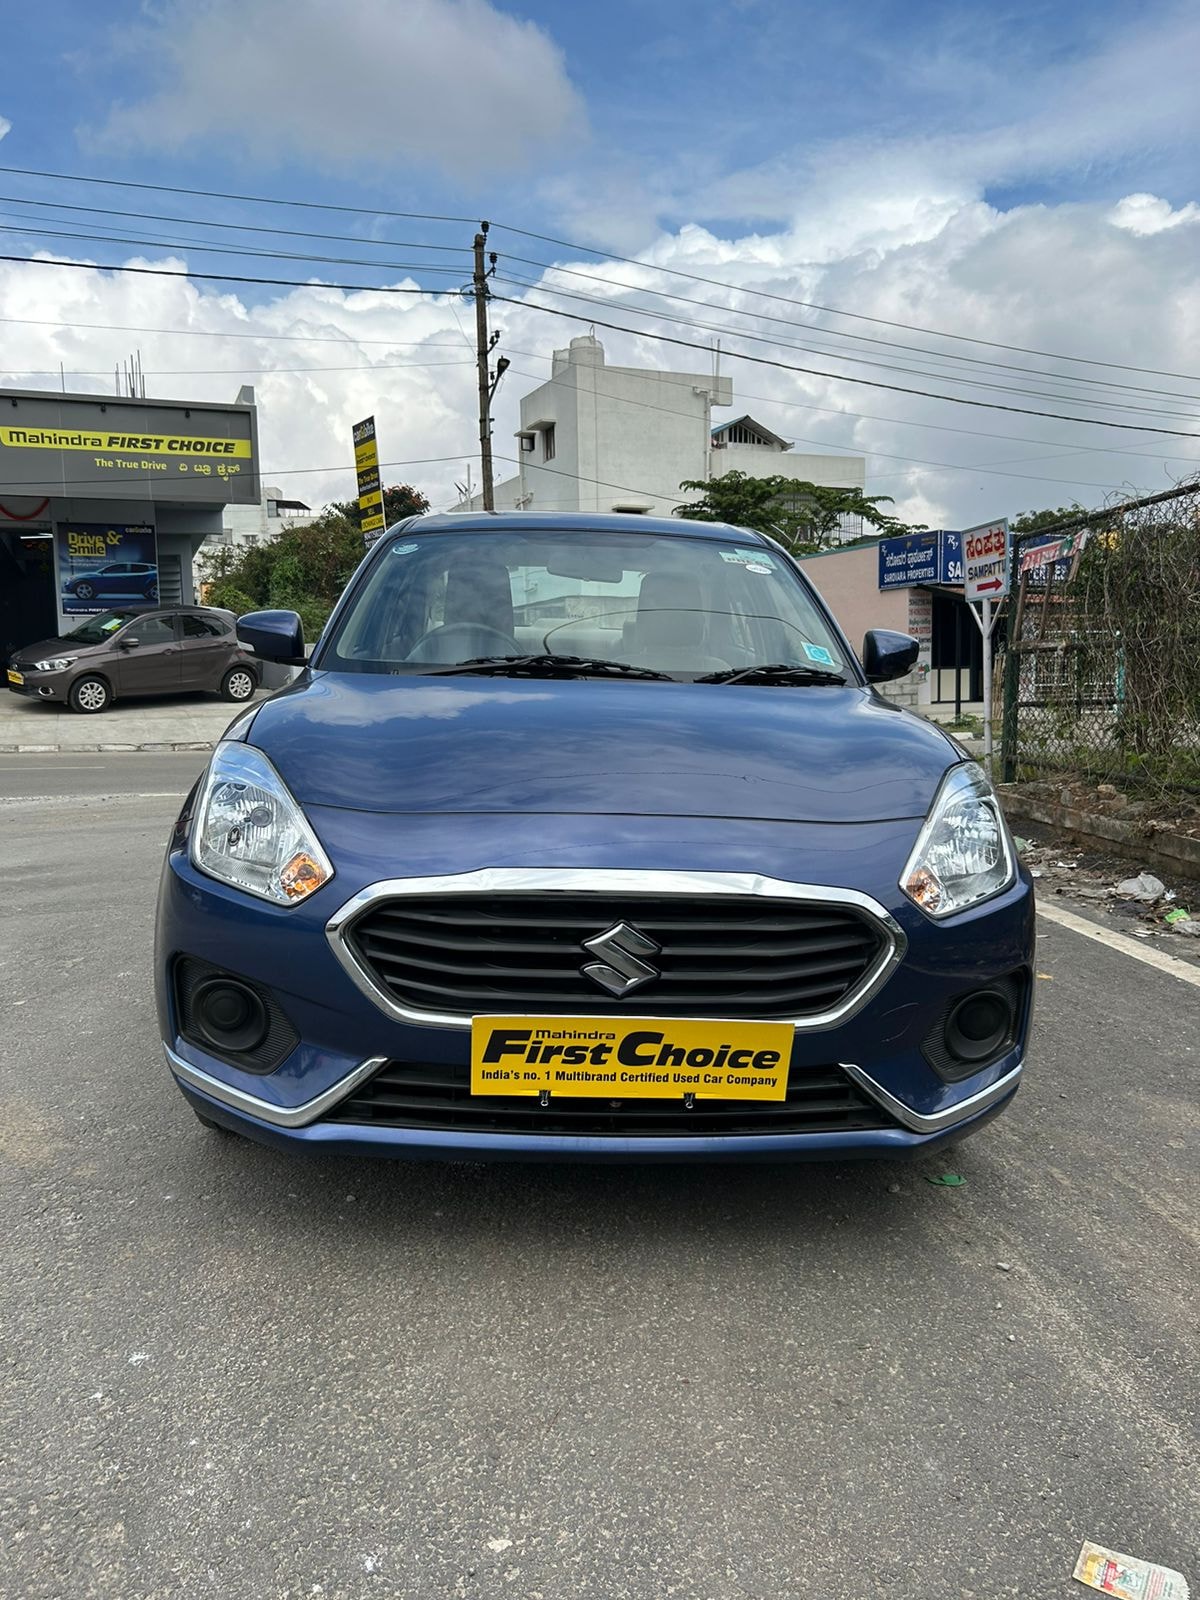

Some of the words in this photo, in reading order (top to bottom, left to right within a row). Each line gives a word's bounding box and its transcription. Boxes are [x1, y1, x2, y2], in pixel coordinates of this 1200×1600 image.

[9, 430, 102, 447] Mahindra
[107, 436, 164, 450] FIRST
[167, 439, 236, 454] CHOICE
[94, 458, 114, 468] The
[115, 459, 139, 469] True
[141, 460, 167, 470] Drive
[67, 532, 104, 545] Drive
[106, 530, 123, 546] &
[68, 543, 105, 555] Smile
[907, 567, 935, 580] PROPERTIES
[967, 559, 1006, 581] SAMPATTU
[535, 1029, 616, 1040] Mahindra
[481, 1029, 614, 1066] First
[617, 1031, 781, 1070] Choice
[481, 1069, 520, 1080] India's
[523, 1072, 541, 1080] no.
[545, 1070, 551, 1080] 1
[555, 1071, 617, 1082] Multibrand
[620, 1072, 669, 1083] Certified
[673, 1073, 700, 1083] Used
[703, 1074, 722, 1084] Car
[726, 1075, 778, 1087] Company
